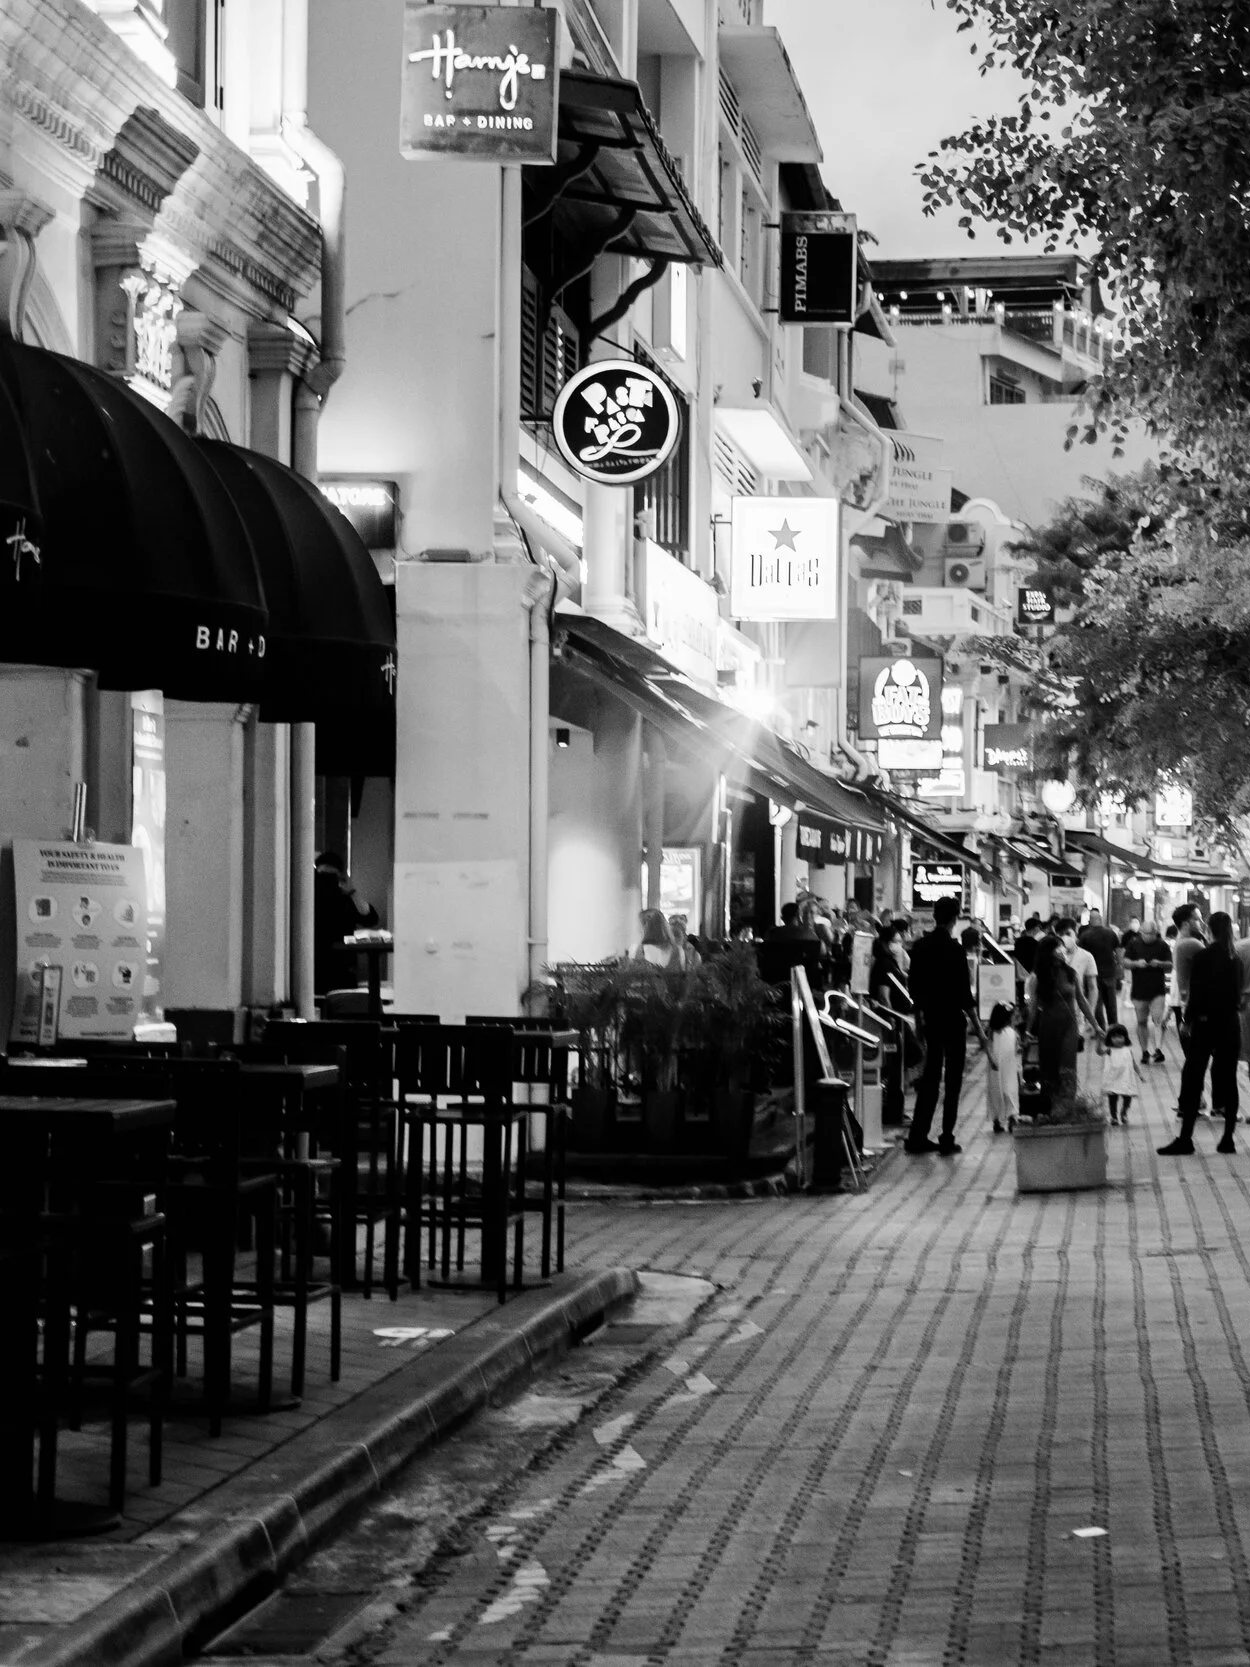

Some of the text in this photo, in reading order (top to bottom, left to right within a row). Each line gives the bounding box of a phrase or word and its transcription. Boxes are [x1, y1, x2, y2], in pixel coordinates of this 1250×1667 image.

[424, 114, 456, 128] BAR
[477, 115, 534, 130] DINING
[795, 236, 808, 312] PIMABS
[580, 377, 653, 415] PASTA
[196, 625, 239, 653] BAR
[884, 685, 923, 704] FAT
